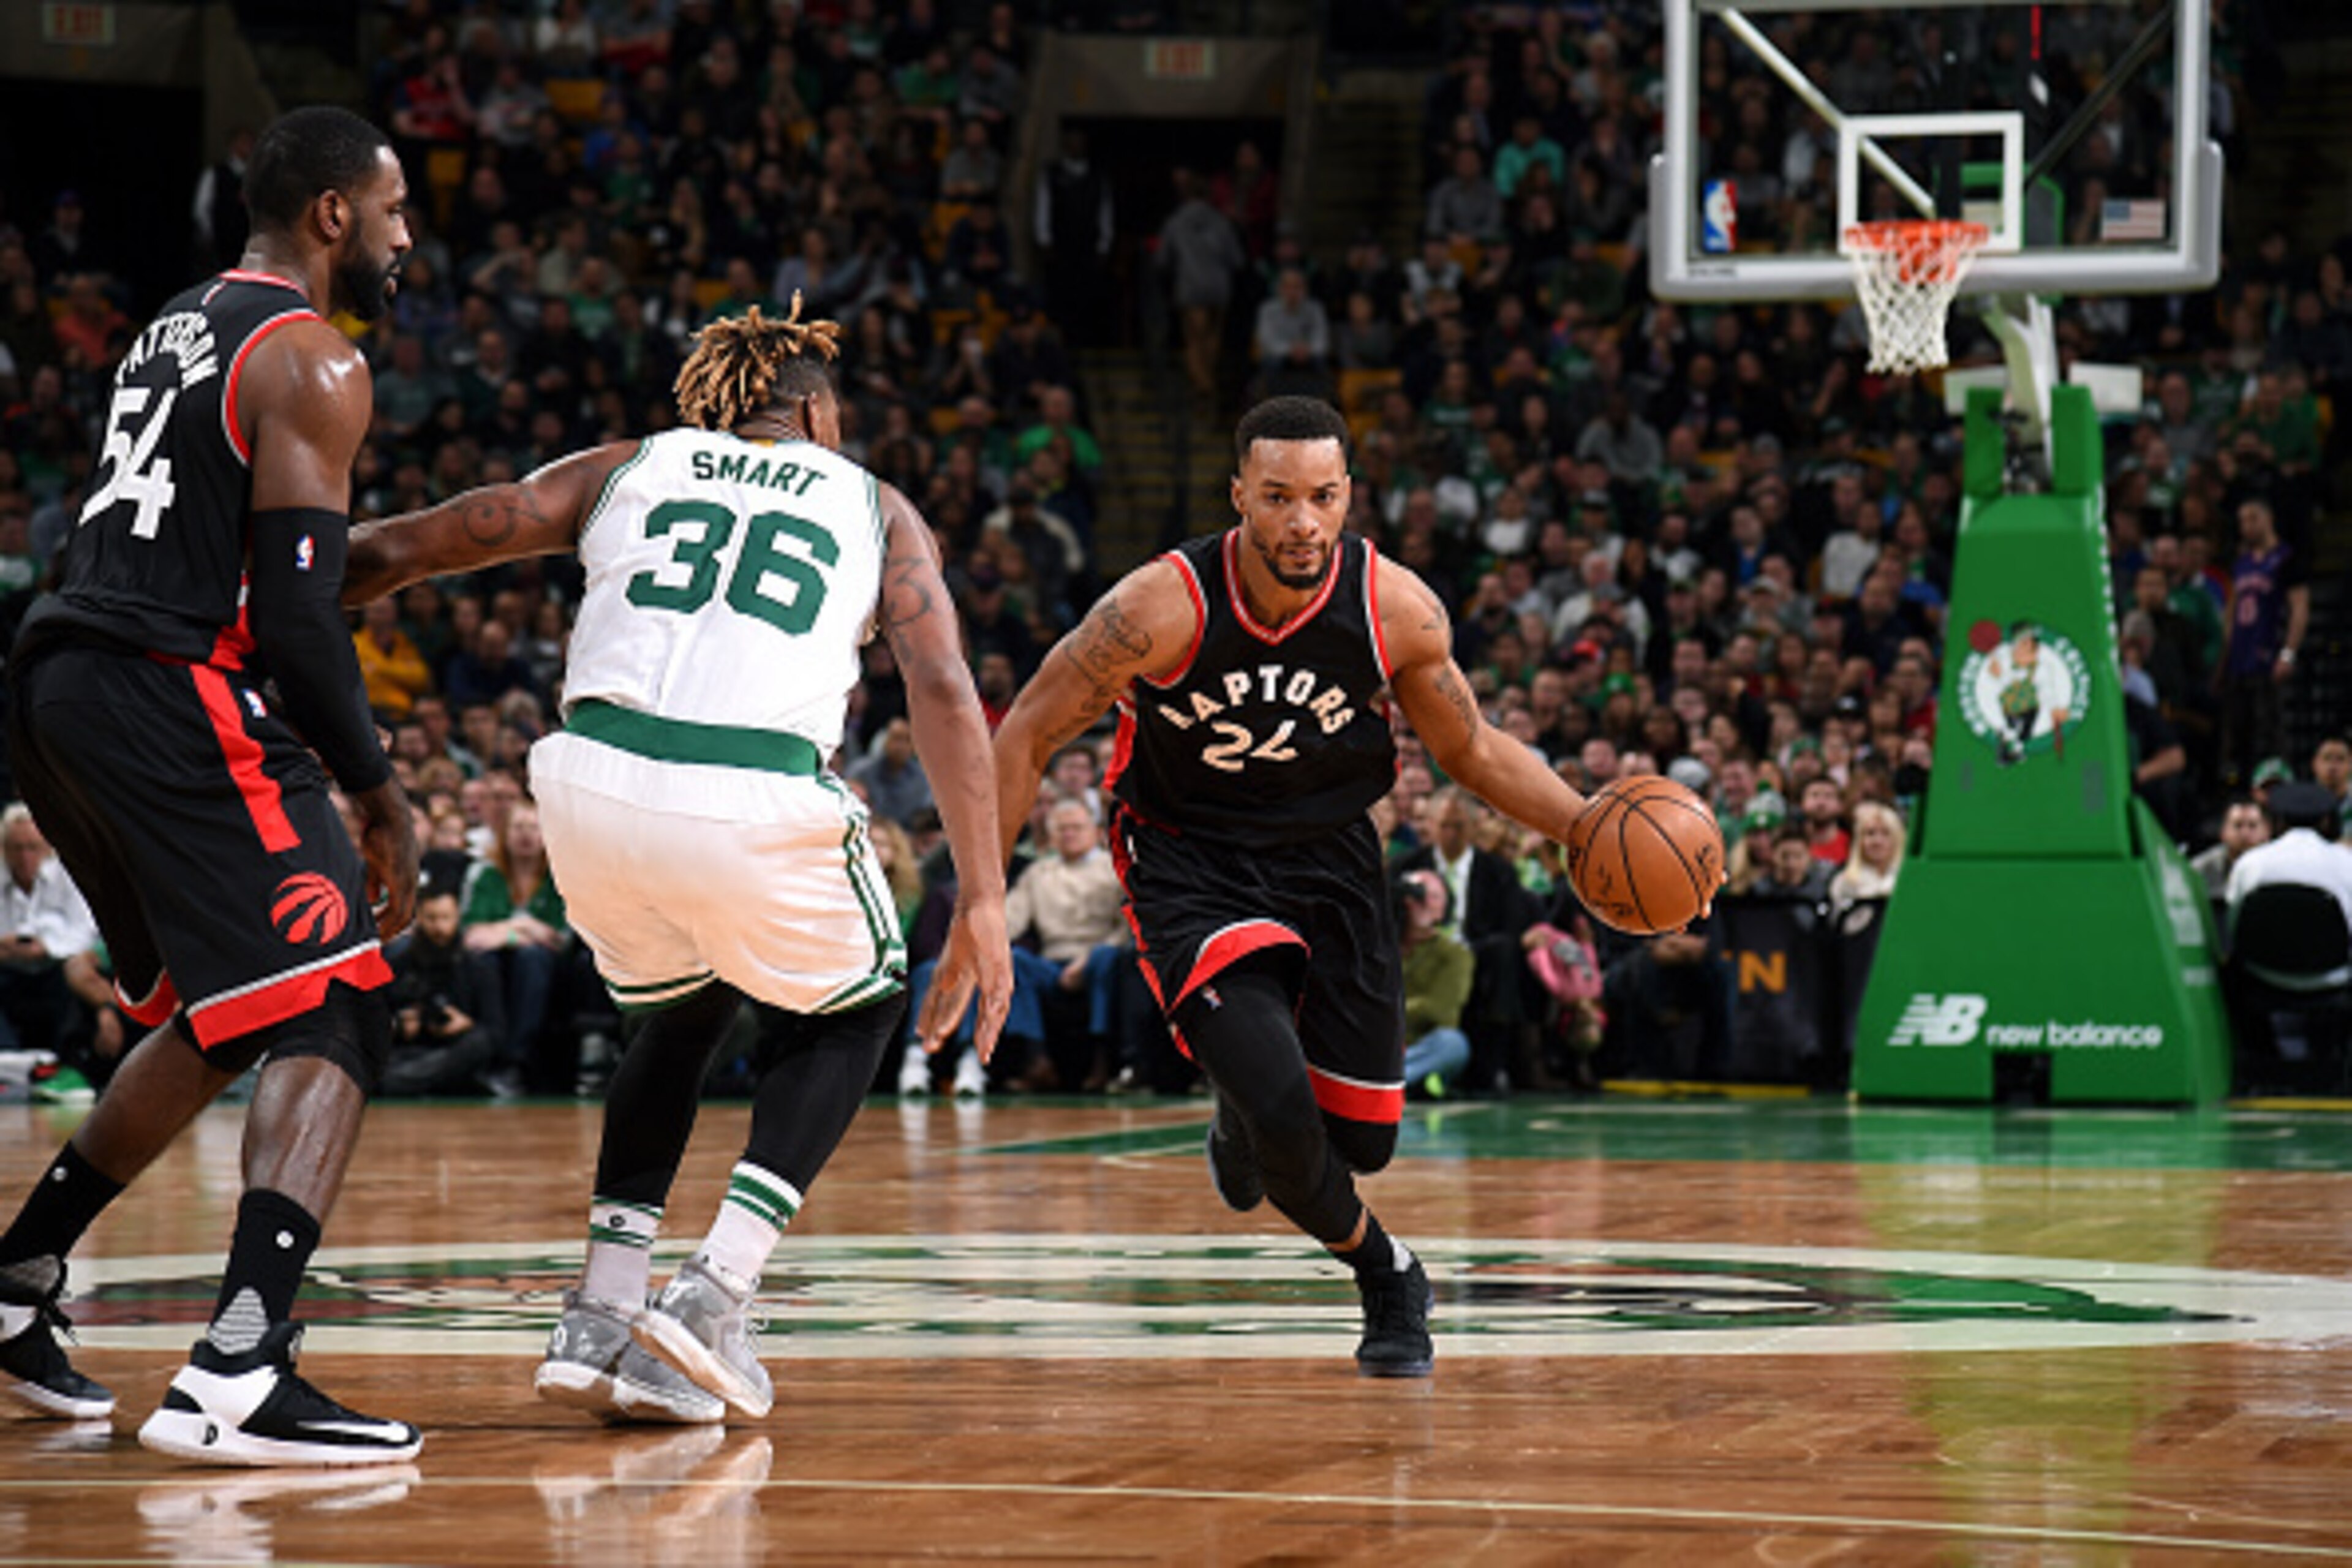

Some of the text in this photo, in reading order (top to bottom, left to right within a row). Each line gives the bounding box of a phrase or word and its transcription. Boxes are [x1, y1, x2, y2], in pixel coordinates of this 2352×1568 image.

[78, 387, 178, 540] 54
[692, 450, 827, 497] SMART
[625, 500, 840, 637] 36
[1986, 1022, 2043, 1046] new
[2047, 1018, 2163, 1046] balance
